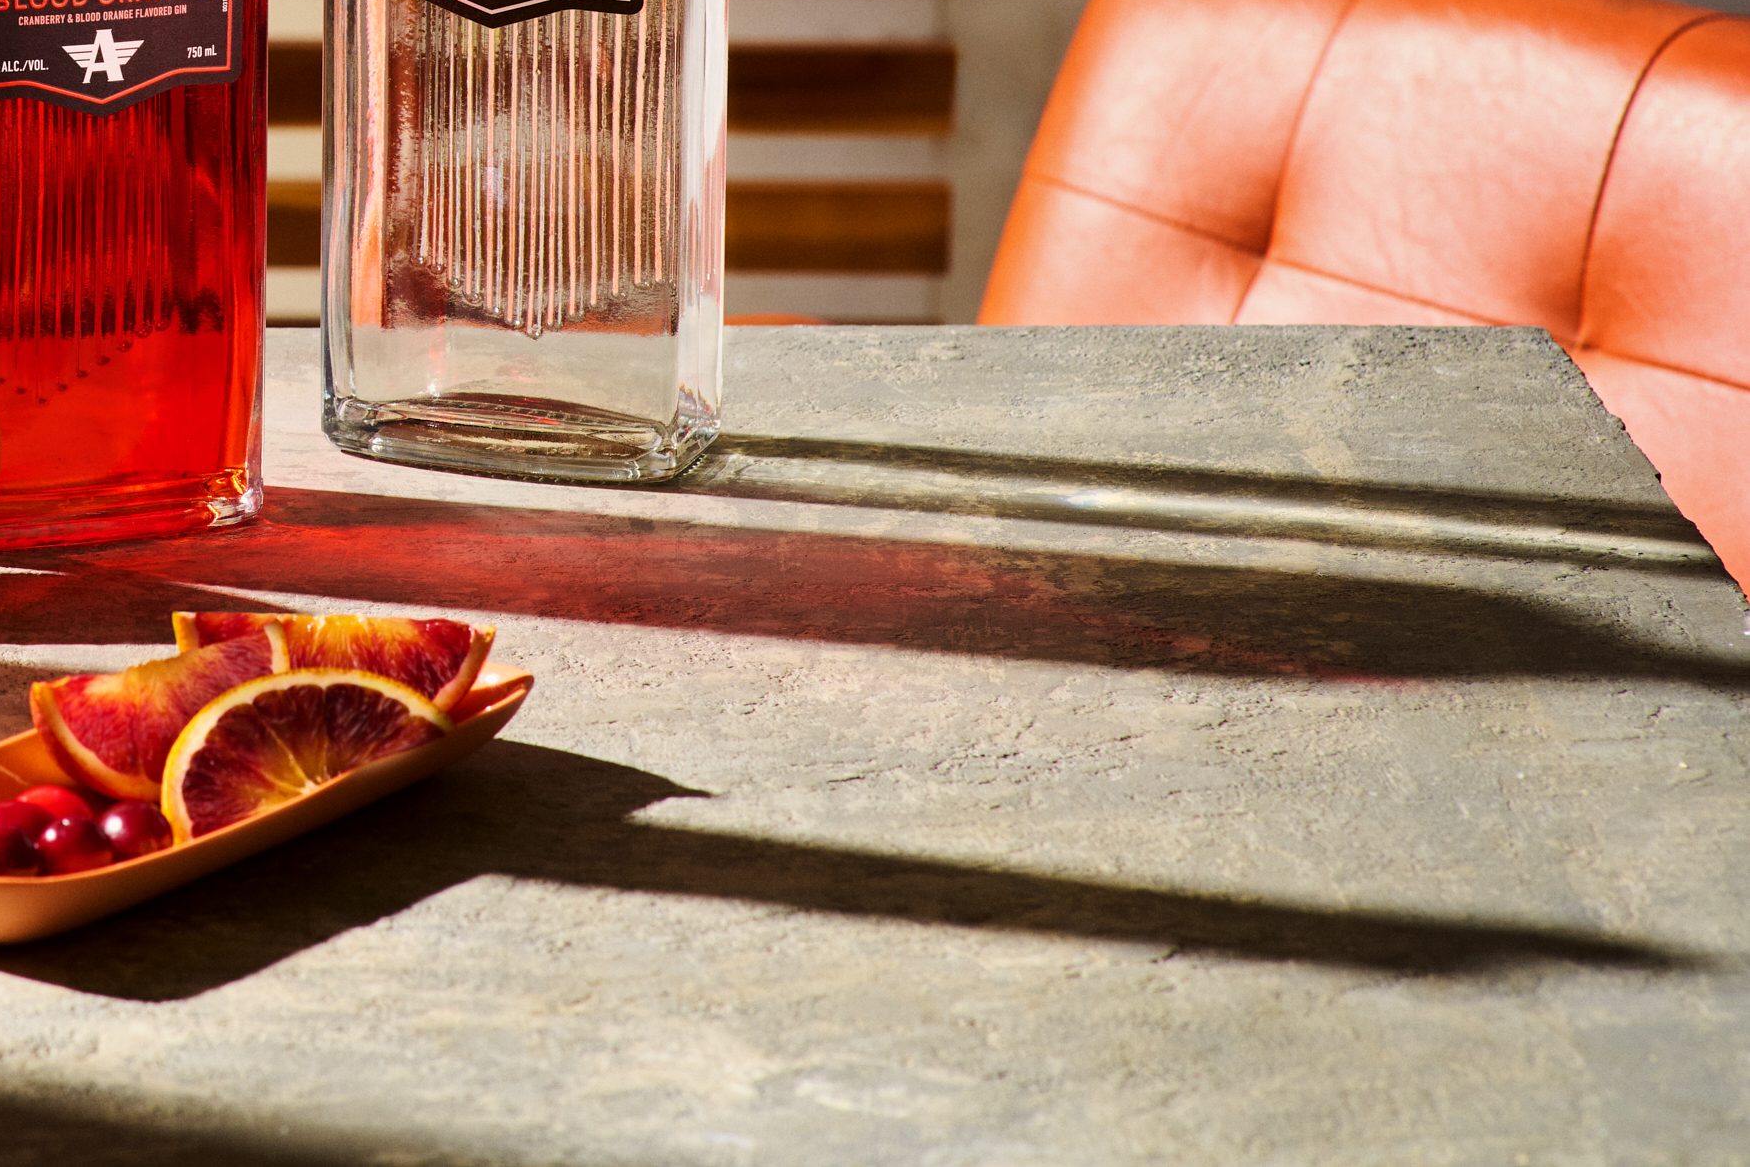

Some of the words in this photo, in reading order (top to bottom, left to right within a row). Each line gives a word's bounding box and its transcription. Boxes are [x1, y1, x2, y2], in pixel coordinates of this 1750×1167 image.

[18, 14, 65, 26] CRANBERRY
[67, 13, 74, 23] &
[75, 11, 100, 23] BLOOD
[103, 9, 134, 21] ORANGE
[135, 6, 172, 18] FLAVORED
[174, 4, 187, 15] GIN
[187, 46, 203, 59] 750
[205, 44, 217, 57] mL
[1, 59, 49, 73] ALC./VOL.
